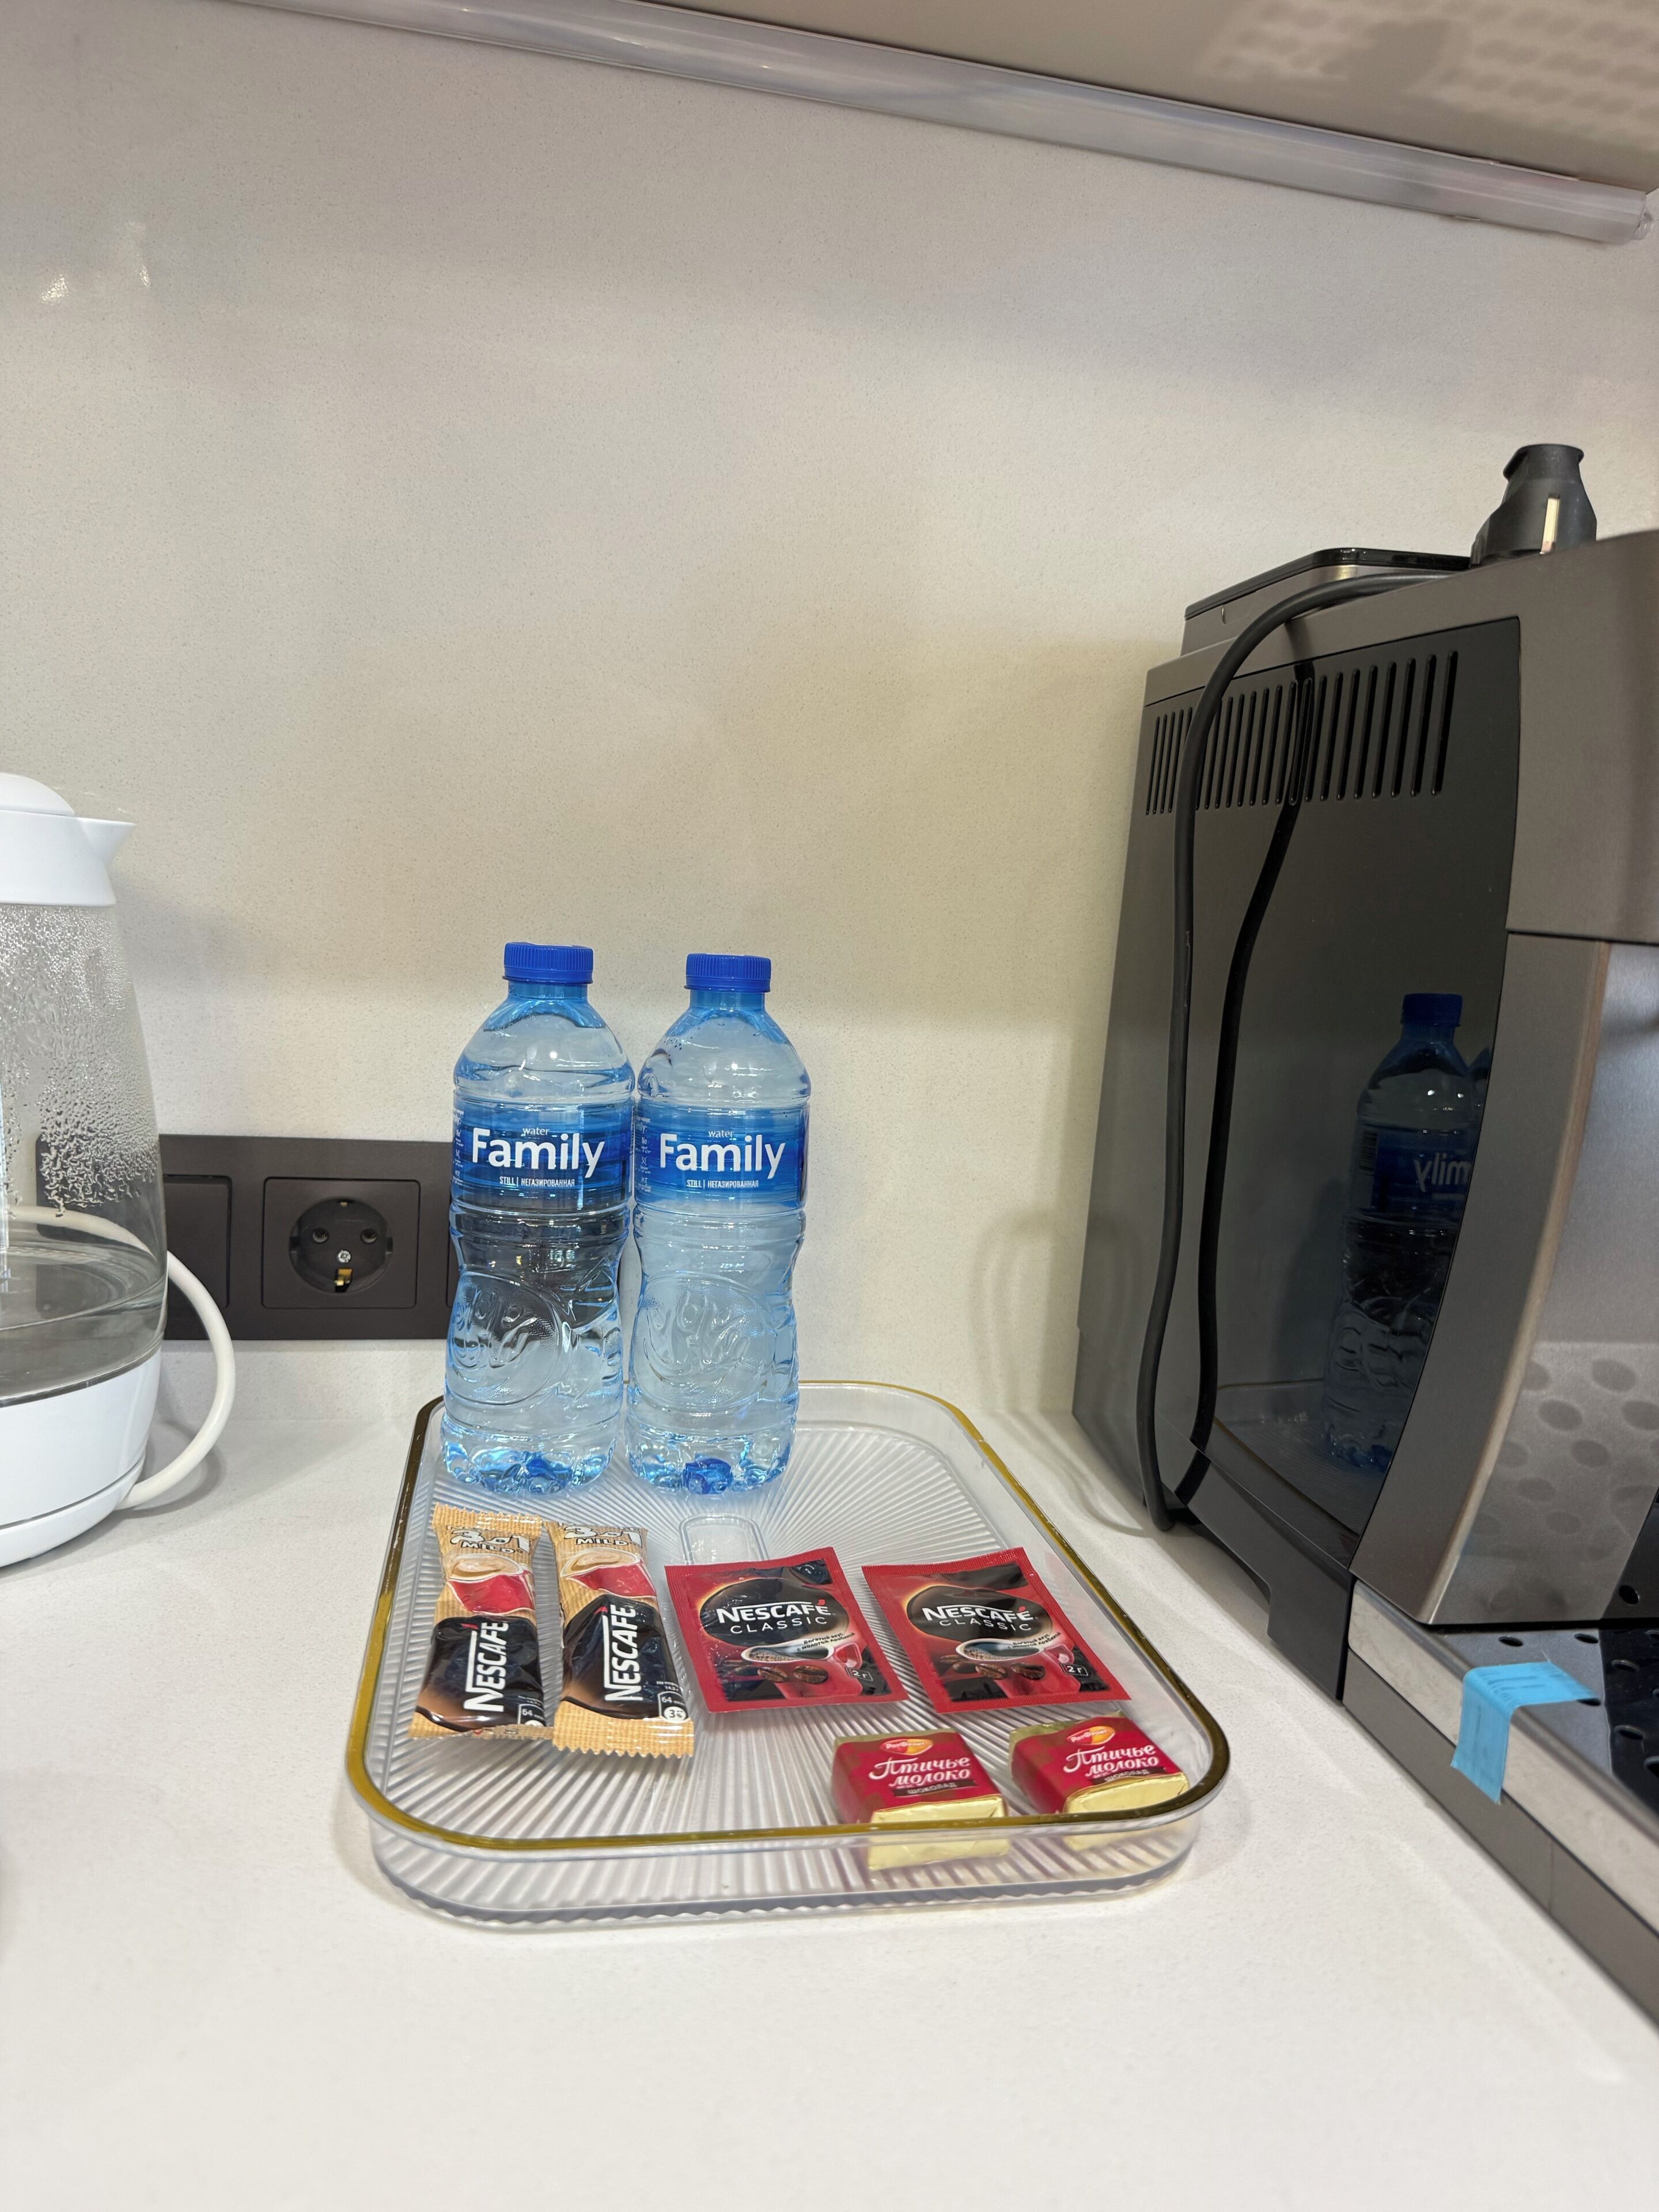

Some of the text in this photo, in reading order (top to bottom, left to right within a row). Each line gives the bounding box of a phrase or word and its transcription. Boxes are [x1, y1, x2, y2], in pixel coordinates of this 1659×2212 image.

[522, 1127, 550, 1135] water
[472, 1127, 605, 1178] Family
[660, 1133, 786, 1179] Family
[499, 1176, 575, 1187] STILL НЕГАЗИРОВАННАЯ
[707, 1180, 759, 1188] НЕГАЗИРОВАННАЯ
[461, 1541, 515, 1554] MILD
[730, 1616, 827, 1634] CLASSIC
[939, 1618, 1031, 1631] CLASSIC
[1063, 1744, 1157, 1773] Птичье
[1085, 1756, 1160, 1777] молоко
[868, 1757, 971, 1780] Птичье
[888, 1768, 971, 1787] молоко
[907, 1782, 957, 1794] ШОКОЛАД
